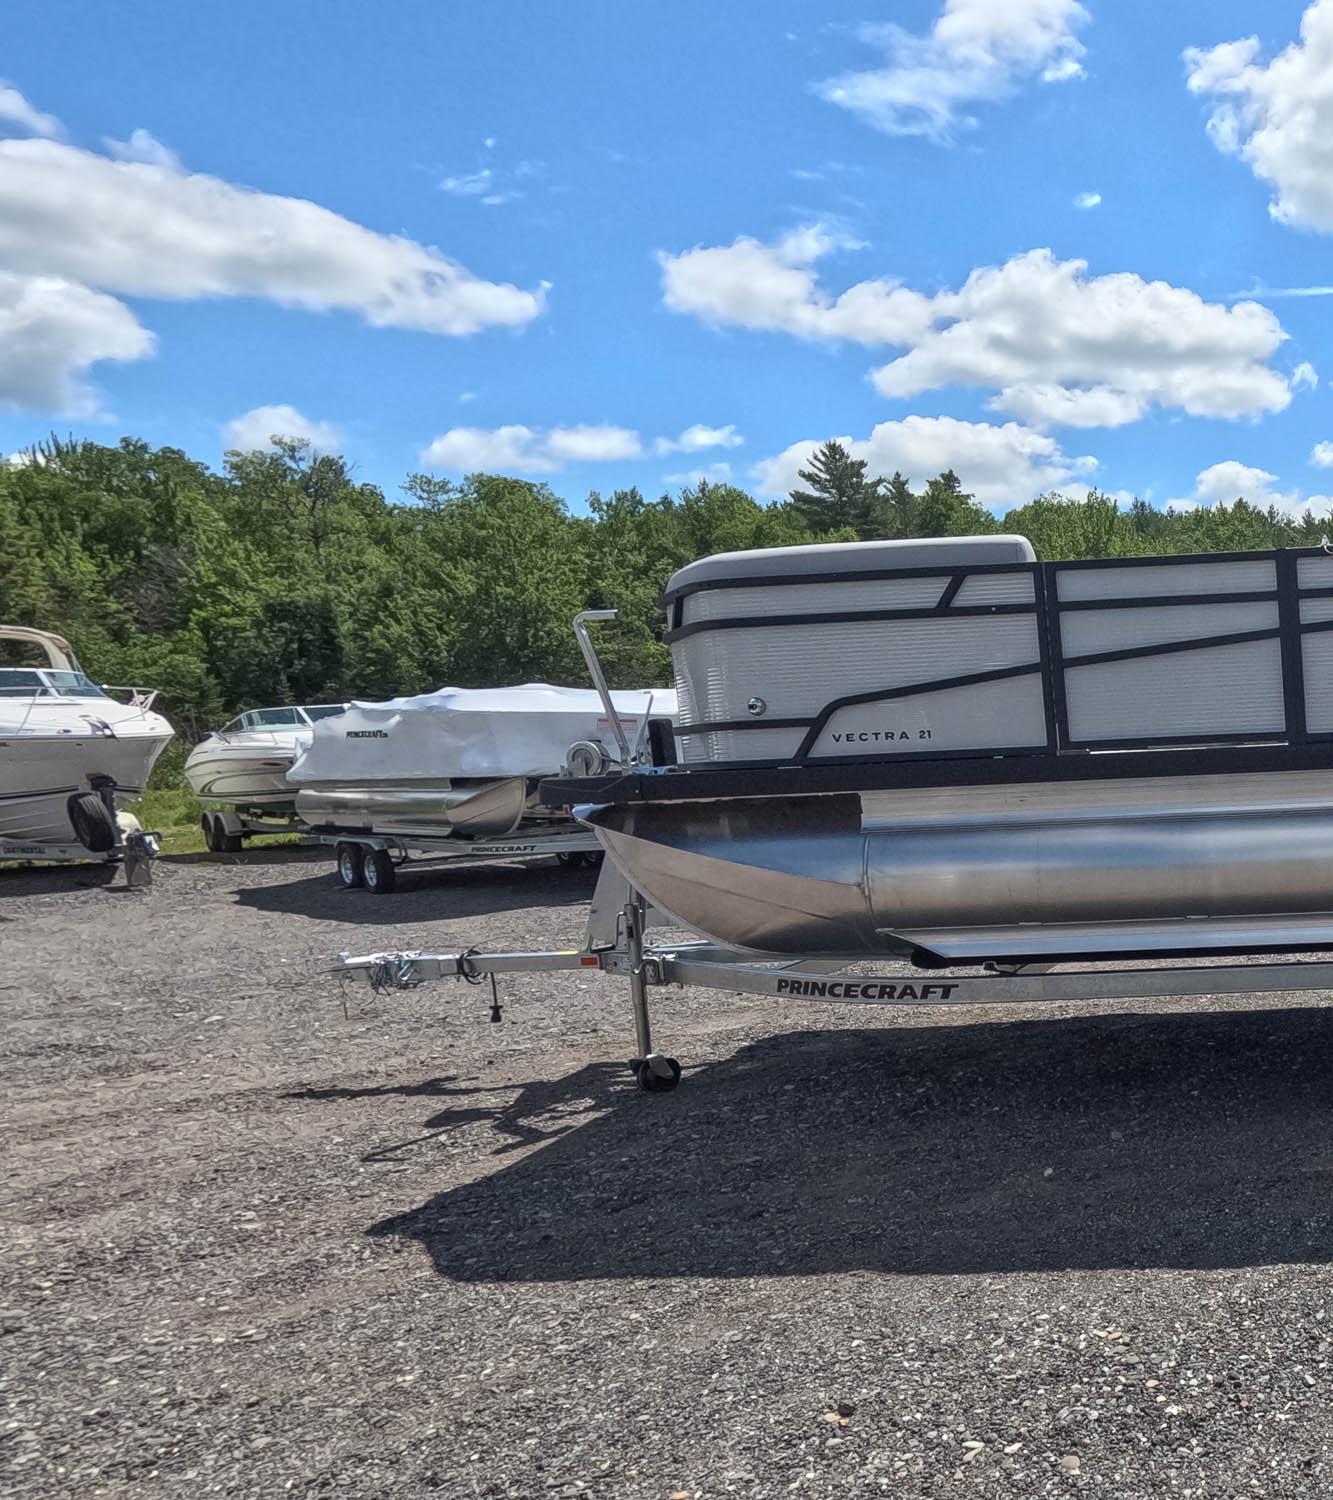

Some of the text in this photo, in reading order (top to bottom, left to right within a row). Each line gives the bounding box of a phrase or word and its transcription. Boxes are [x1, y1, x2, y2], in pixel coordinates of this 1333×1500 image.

[832, 730, 932, 742] VECTRA 21
[471, 845, 536, 853] PRINCECRAFT
[776, 979, 960, 1000] PRINCECRAFT
